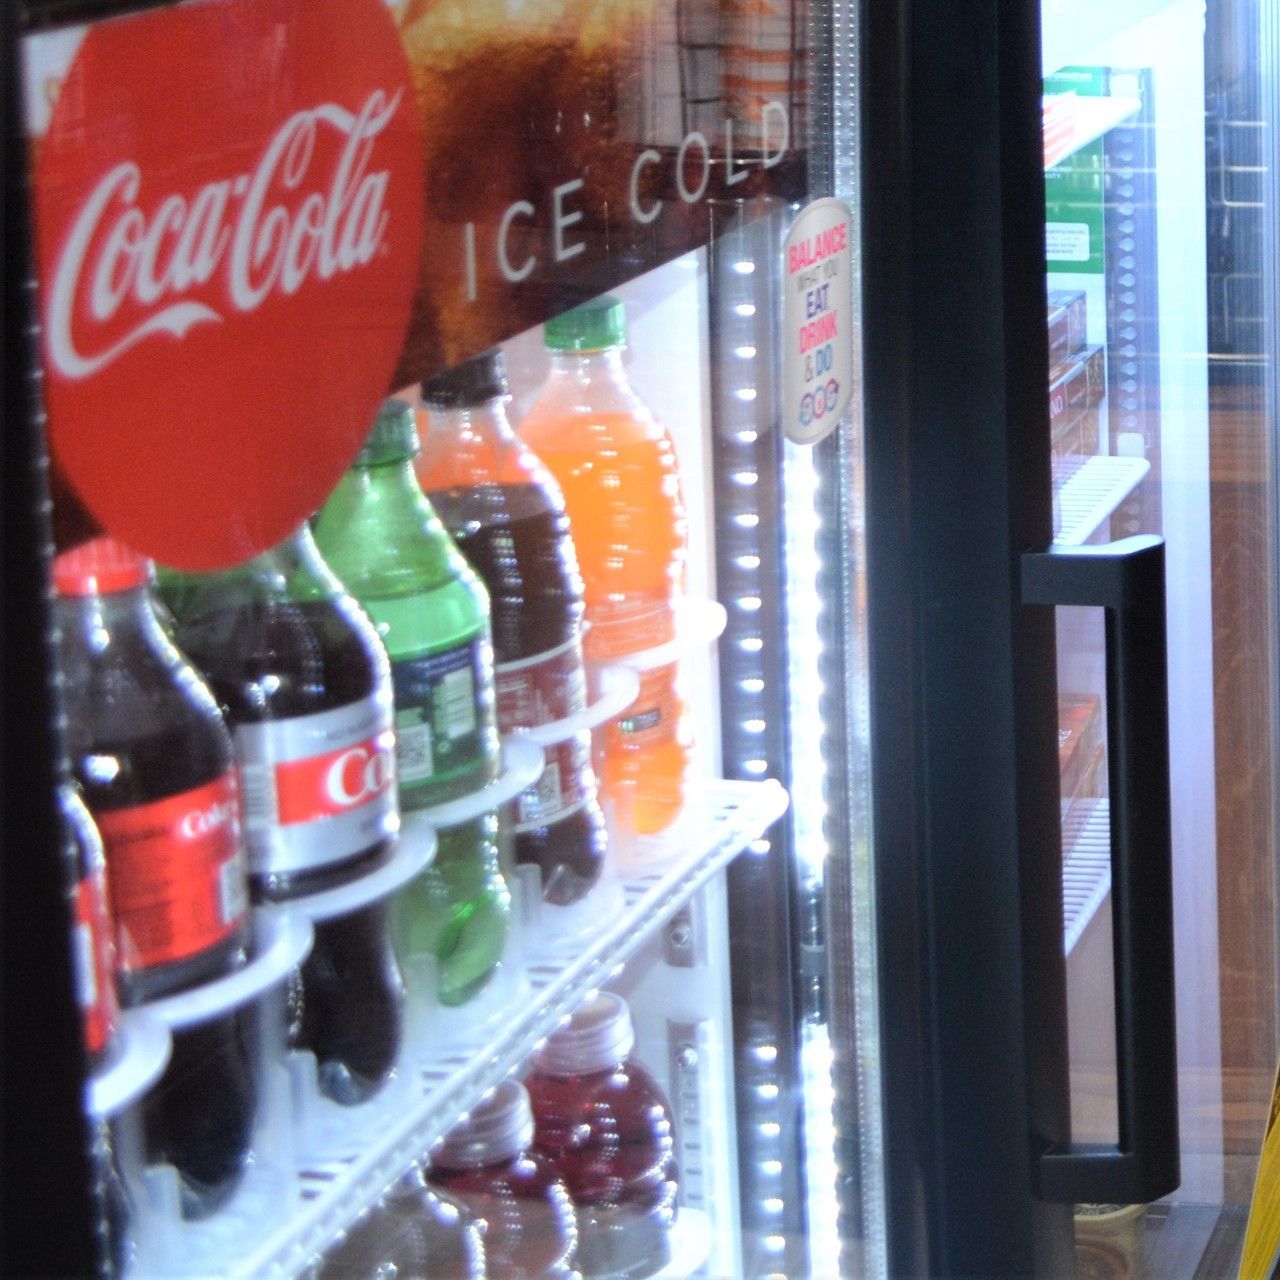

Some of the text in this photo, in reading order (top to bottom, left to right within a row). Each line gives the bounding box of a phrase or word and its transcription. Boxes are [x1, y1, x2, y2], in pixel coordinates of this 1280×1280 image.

[464, 101, 790, 302] ICE COLD
[46, 87, 402, 380] Coca-Cola
[788, 222, 848, 275] BALANCE
[807, 283, 829, 318] EAT
[799, 310, 838, 355] DRINK
[816, 344, 833, 376] DO
